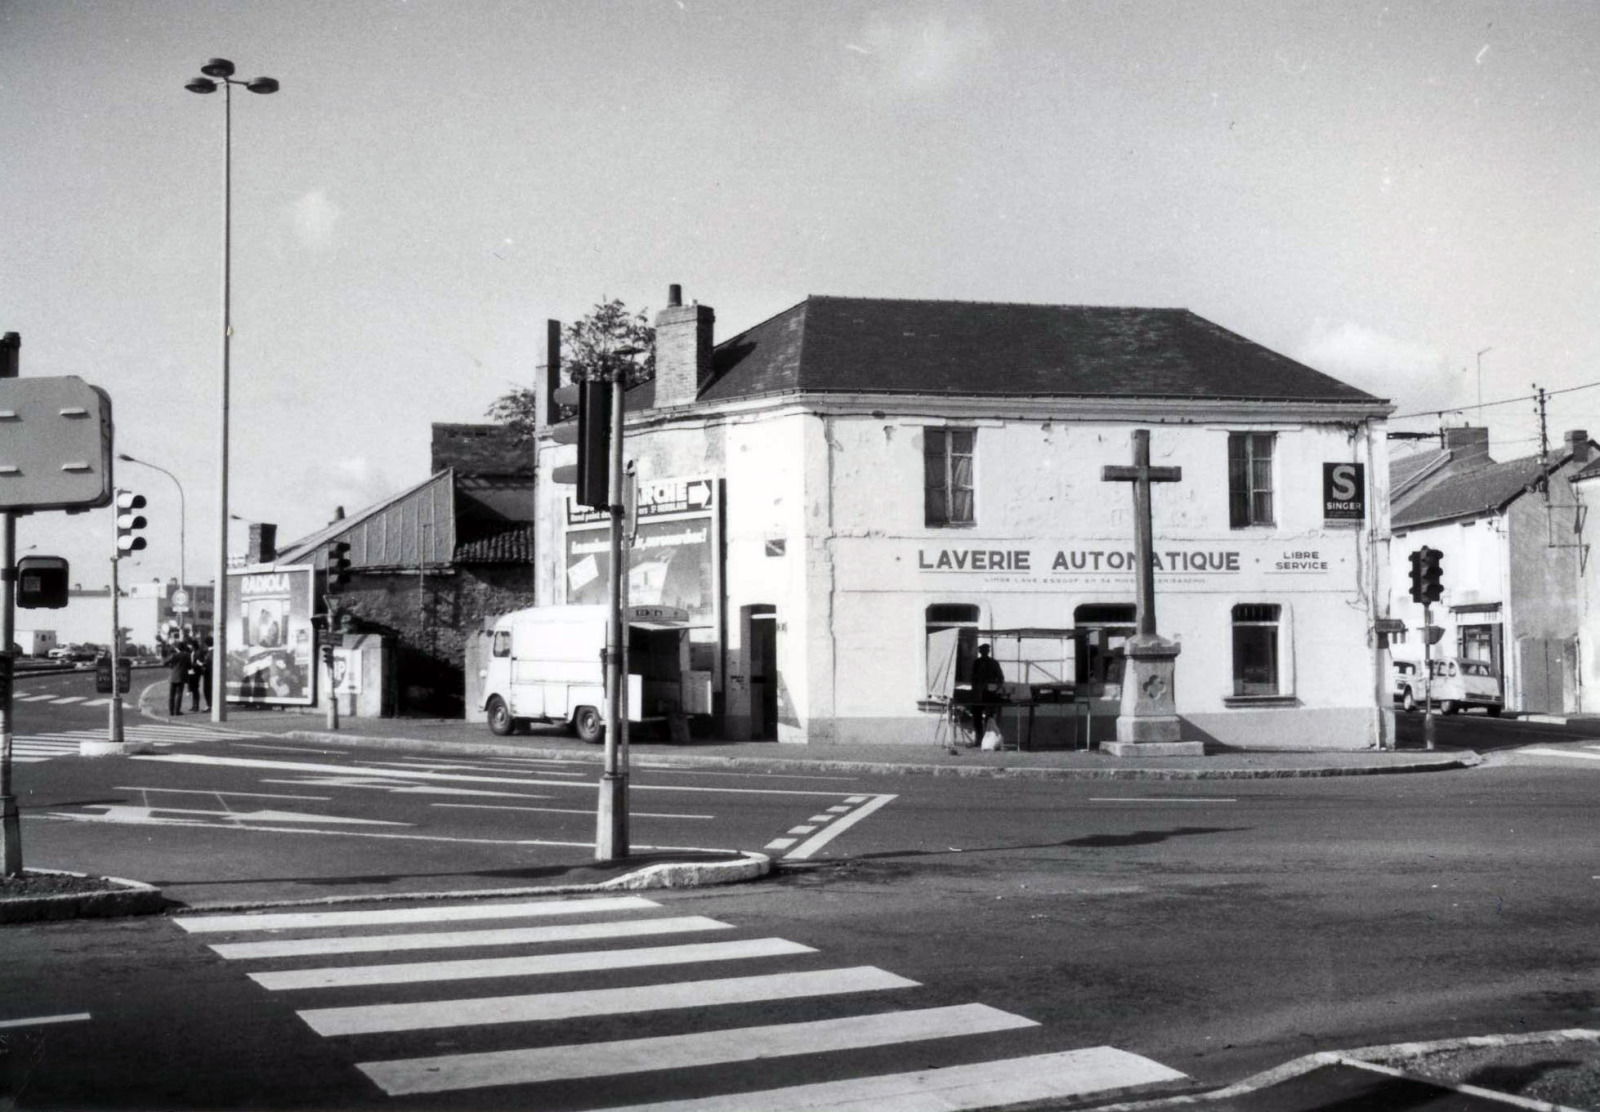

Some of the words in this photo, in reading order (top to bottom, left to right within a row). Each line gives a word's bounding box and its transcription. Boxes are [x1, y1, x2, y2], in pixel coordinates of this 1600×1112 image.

[1332, 465, 1356, 500] S
[1326, 502, 1361, 511] SINGER
[918, 549, 1031, 570] LAVERIE
[1283, 551, 1320, 559] LIBRE
[1275, 562, 1328, 570] SERVICE
[241, 573, 291, 594] RADIOLA
